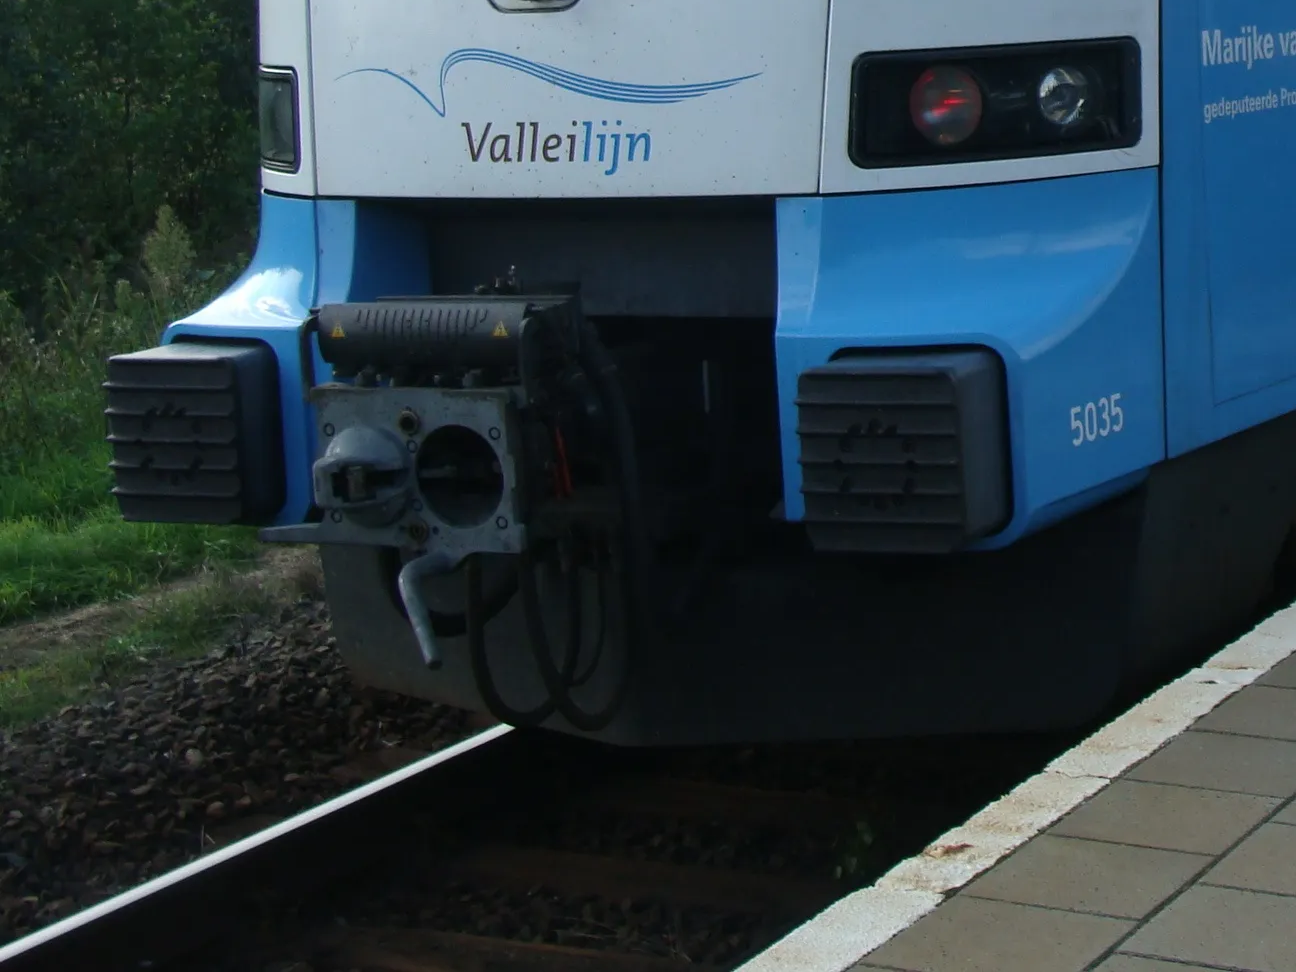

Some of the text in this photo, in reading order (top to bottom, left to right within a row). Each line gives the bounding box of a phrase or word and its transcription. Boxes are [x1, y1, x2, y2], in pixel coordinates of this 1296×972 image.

[1201, 25, 1274, 70] Marijke
[1203, 89, 1279, 124] gedeputeerde
[460, 119, 652, 176] Valleilijn
[1070, 392, 1124, 447] 5035
